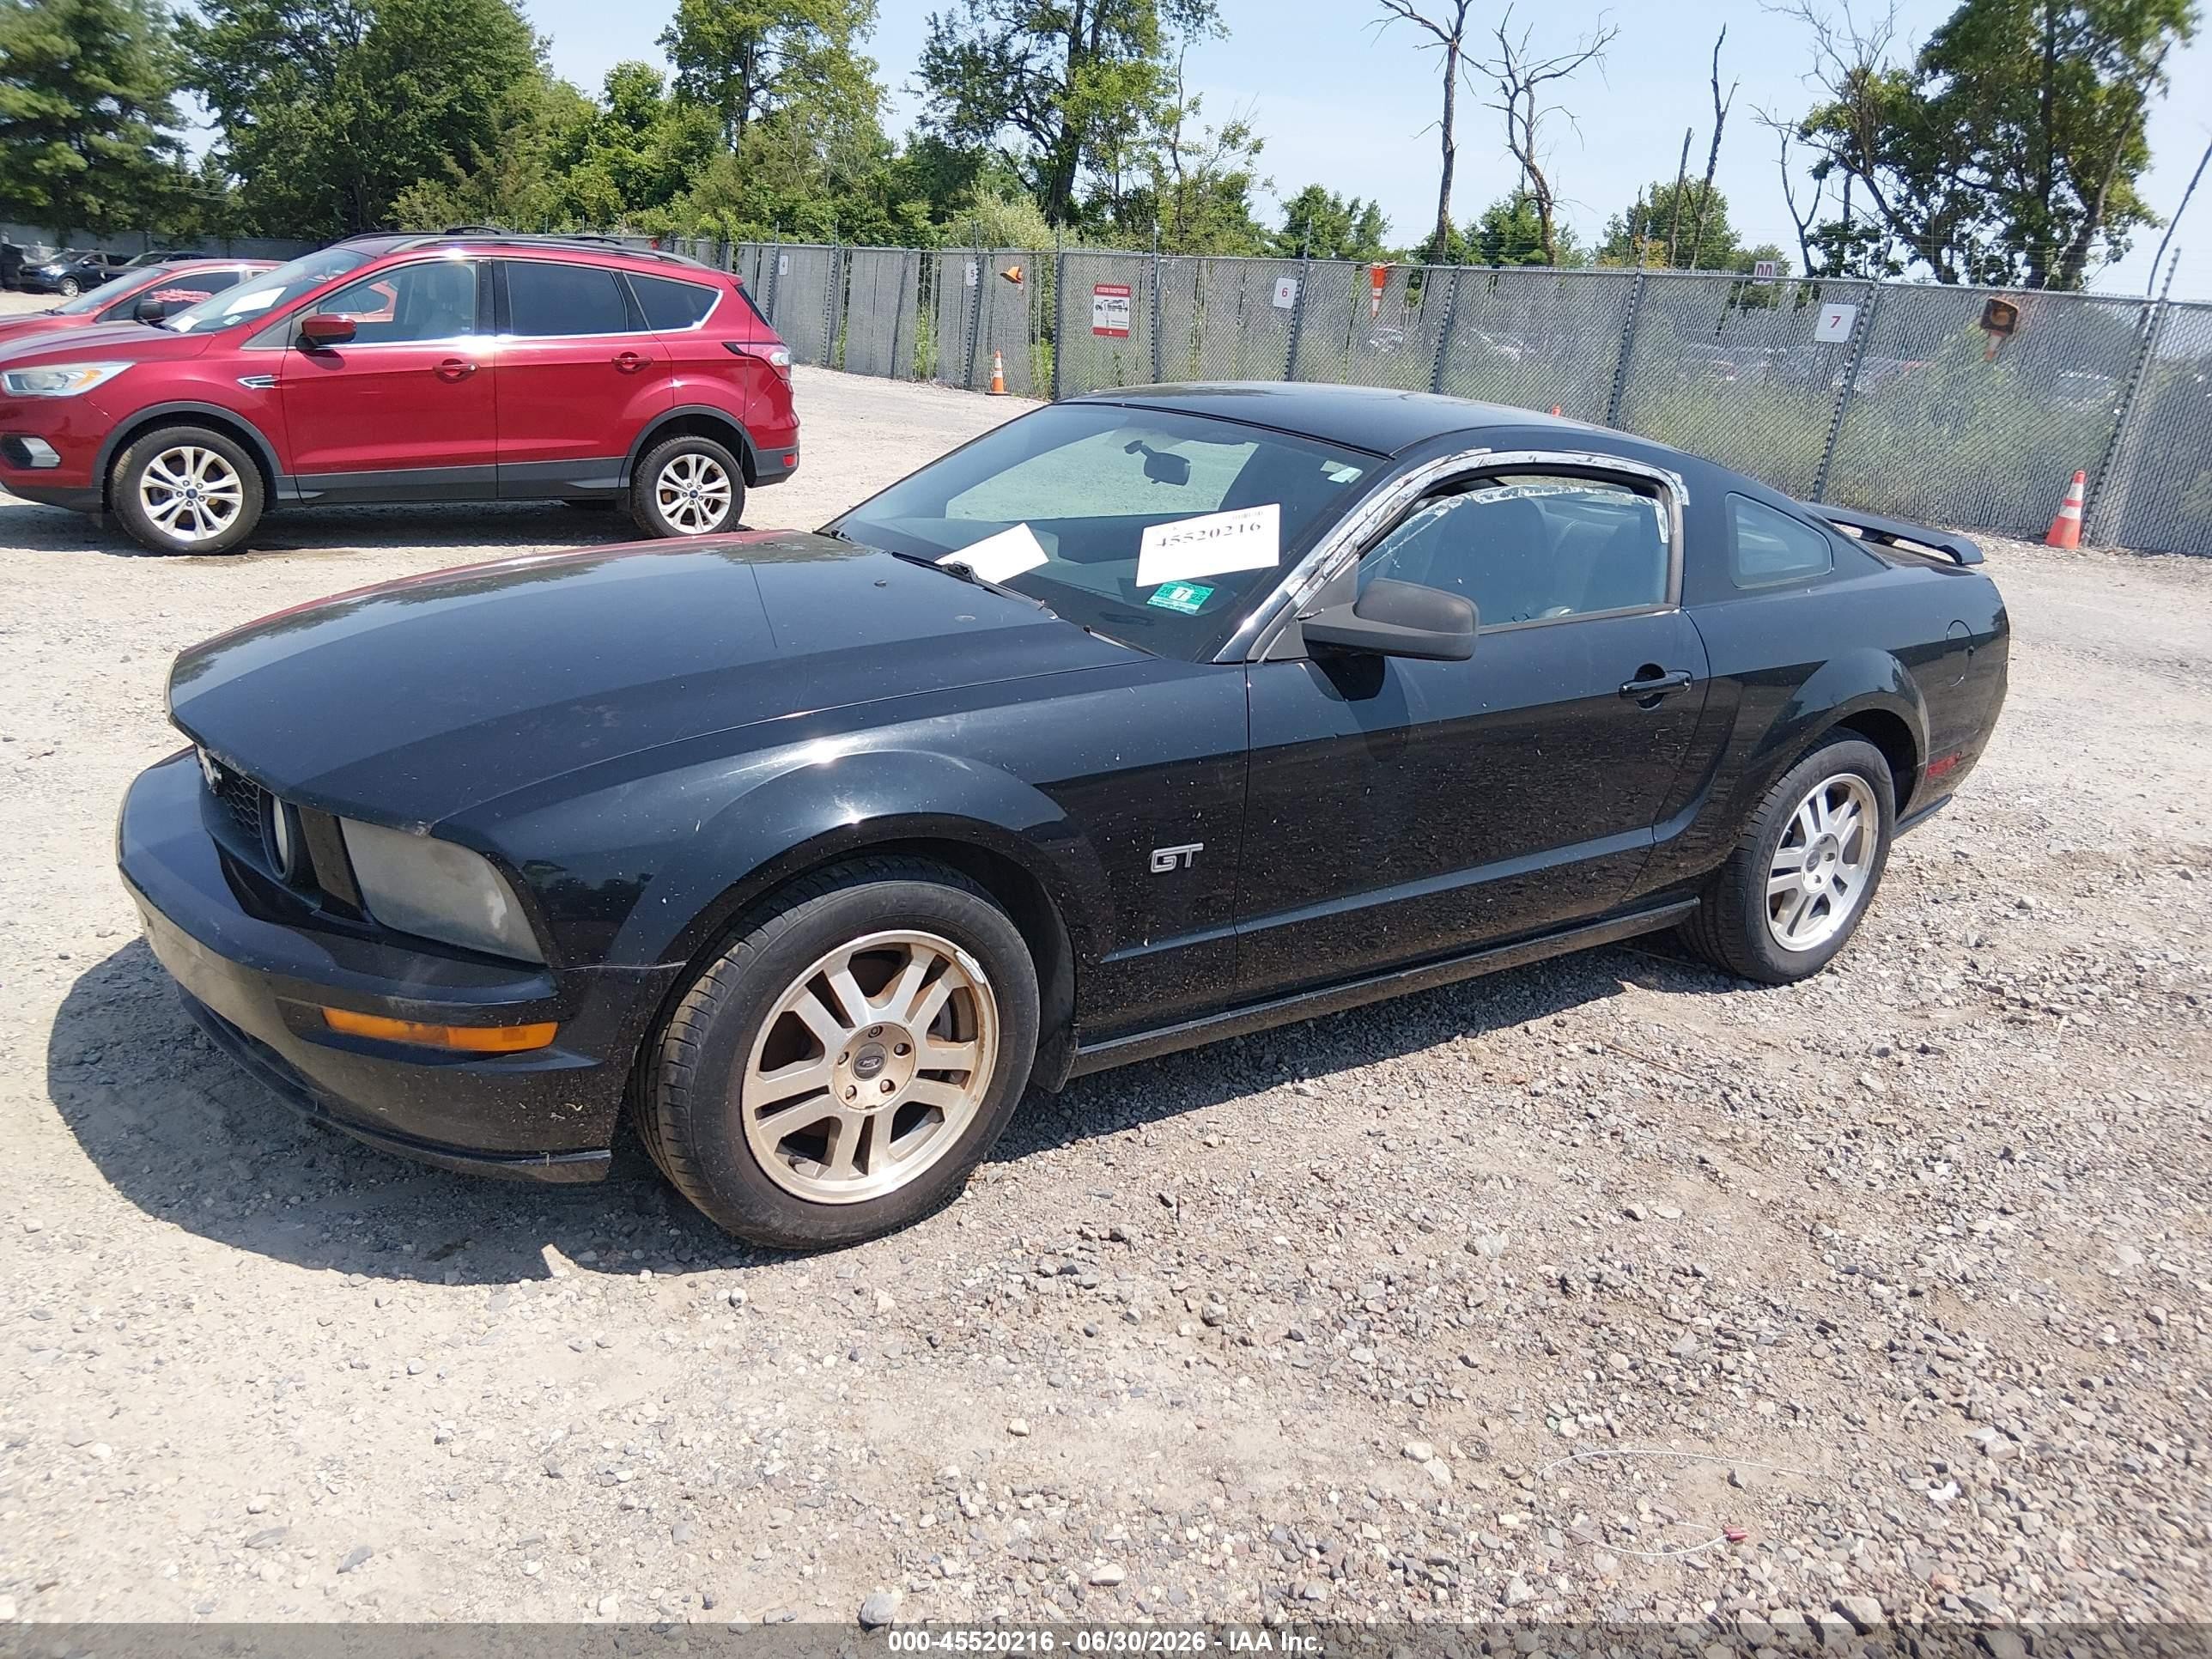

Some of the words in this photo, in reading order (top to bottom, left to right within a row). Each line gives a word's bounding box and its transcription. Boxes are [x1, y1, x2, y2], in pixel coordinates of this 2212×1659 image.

[1281, 287, 1288, 297] 6
[1830, 315, 1842, 329] 7
[1155, 521, 1261, 547] 45520216
[1151, 842, 1204, 873] GT
